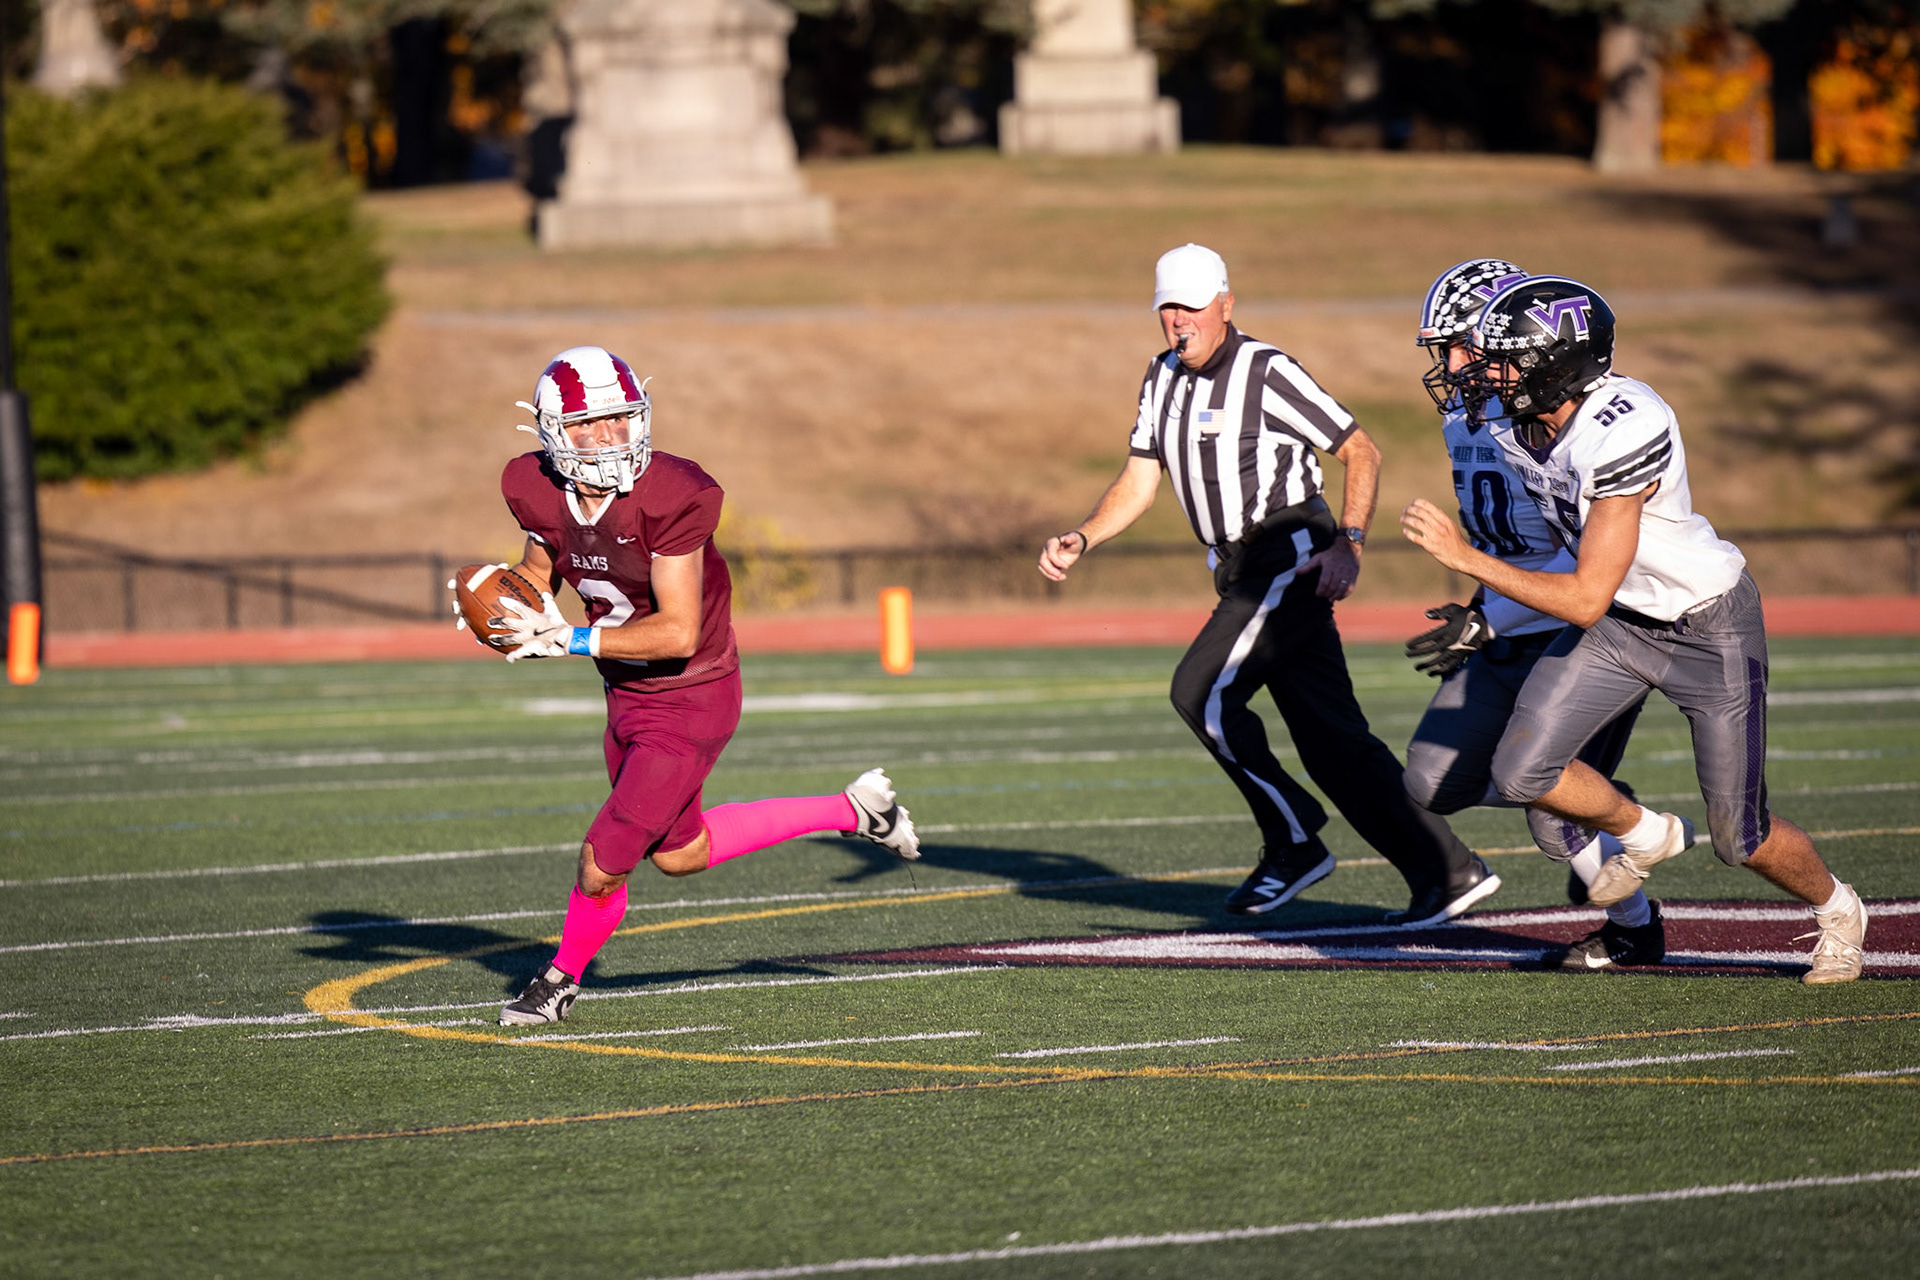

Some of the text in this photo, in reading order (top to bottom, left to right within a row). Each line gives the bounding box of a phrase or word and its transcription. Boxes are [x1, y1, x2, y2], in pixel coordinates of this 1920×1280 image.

[1524, 295, 1592, 341] VT
[1592, 392, 1636, 427] 55
[570, 552, 609, 571] RAMS
